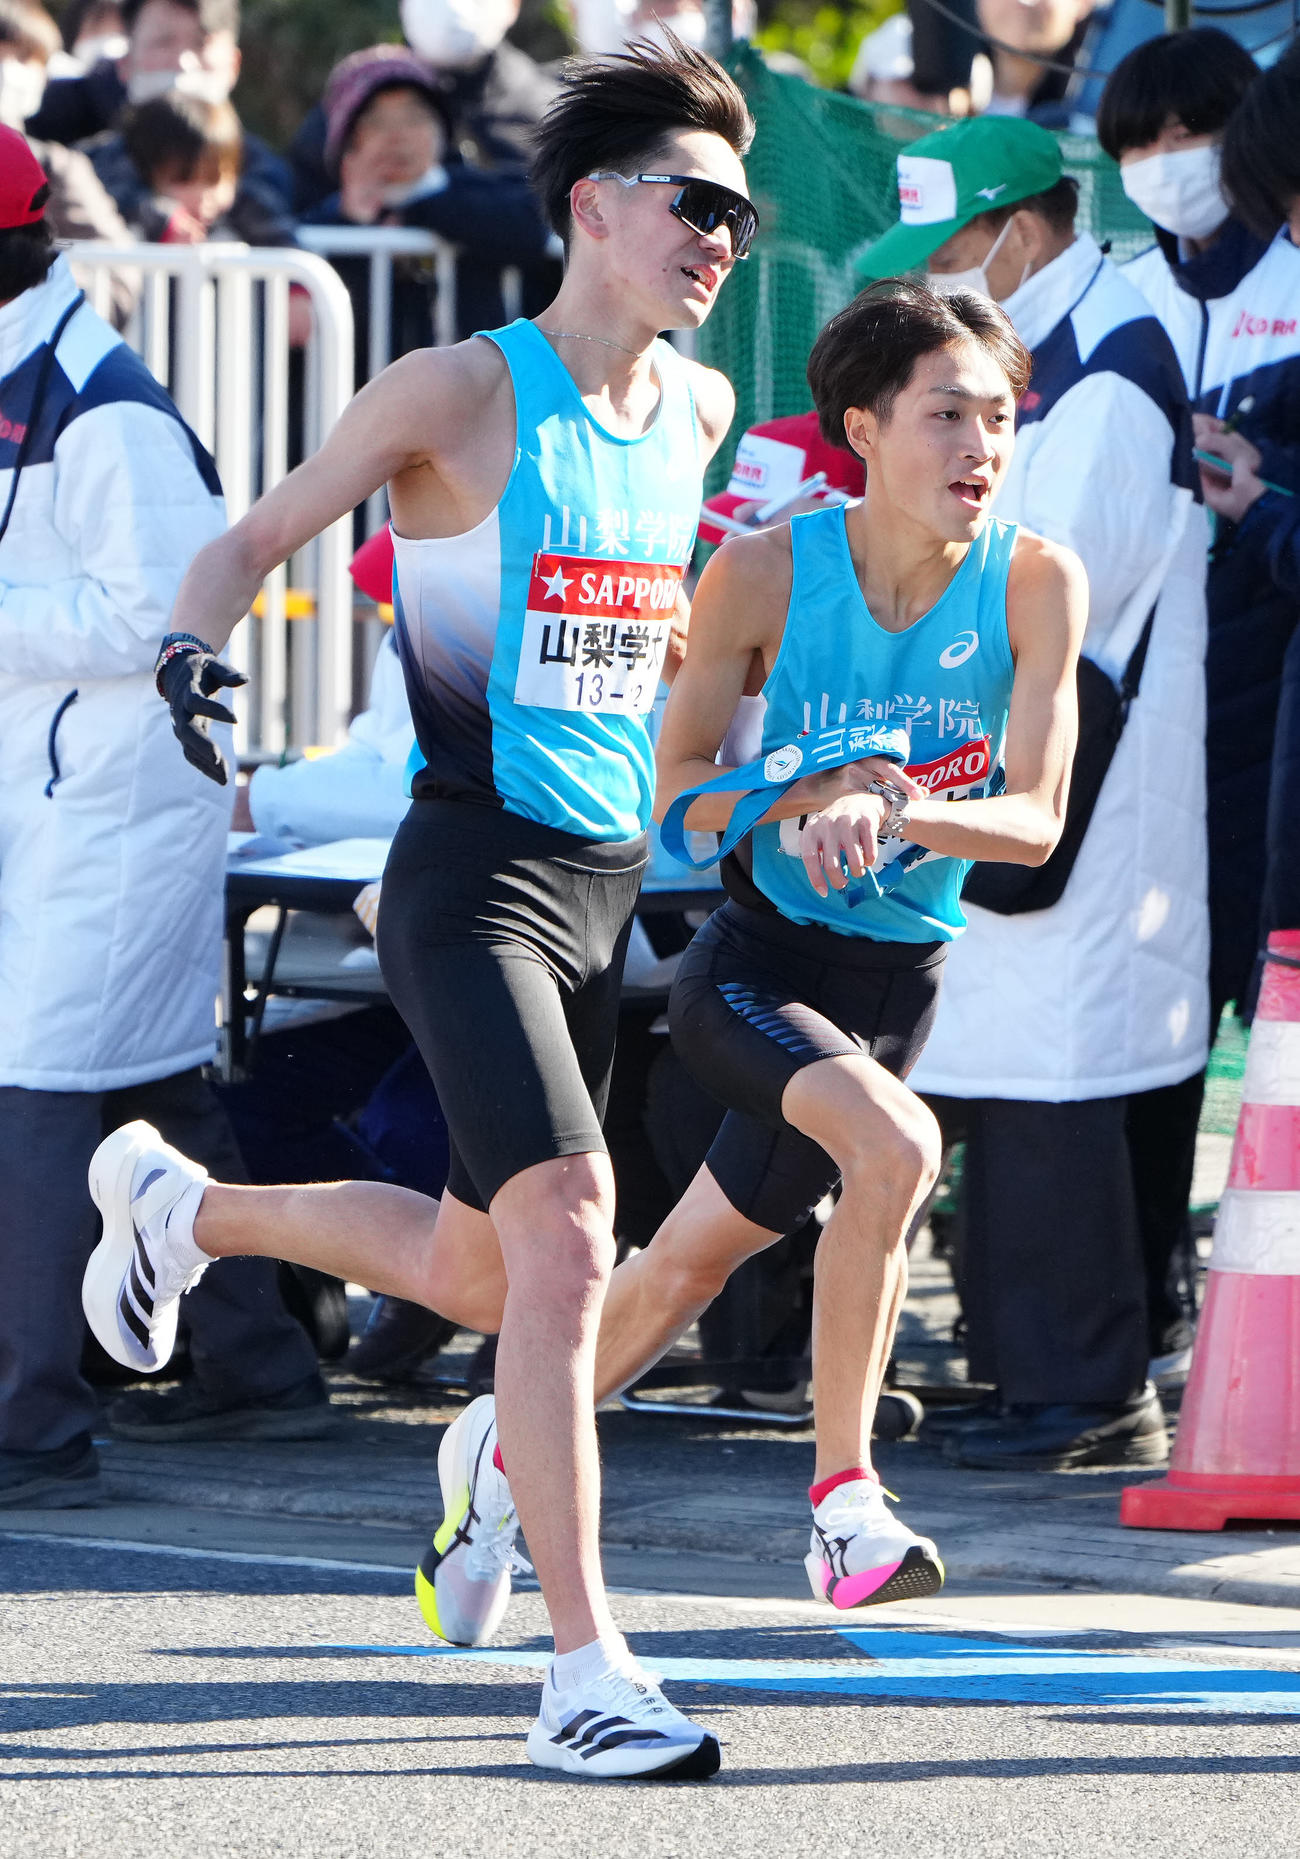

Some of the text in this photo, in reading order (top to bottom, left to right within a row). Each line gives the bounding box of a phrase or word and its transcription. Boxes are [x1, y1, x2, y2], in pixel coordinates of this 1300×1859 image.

[542, 504, 693, 560] 山梨学院
[539, 619, 663, 671] 山梨学大
